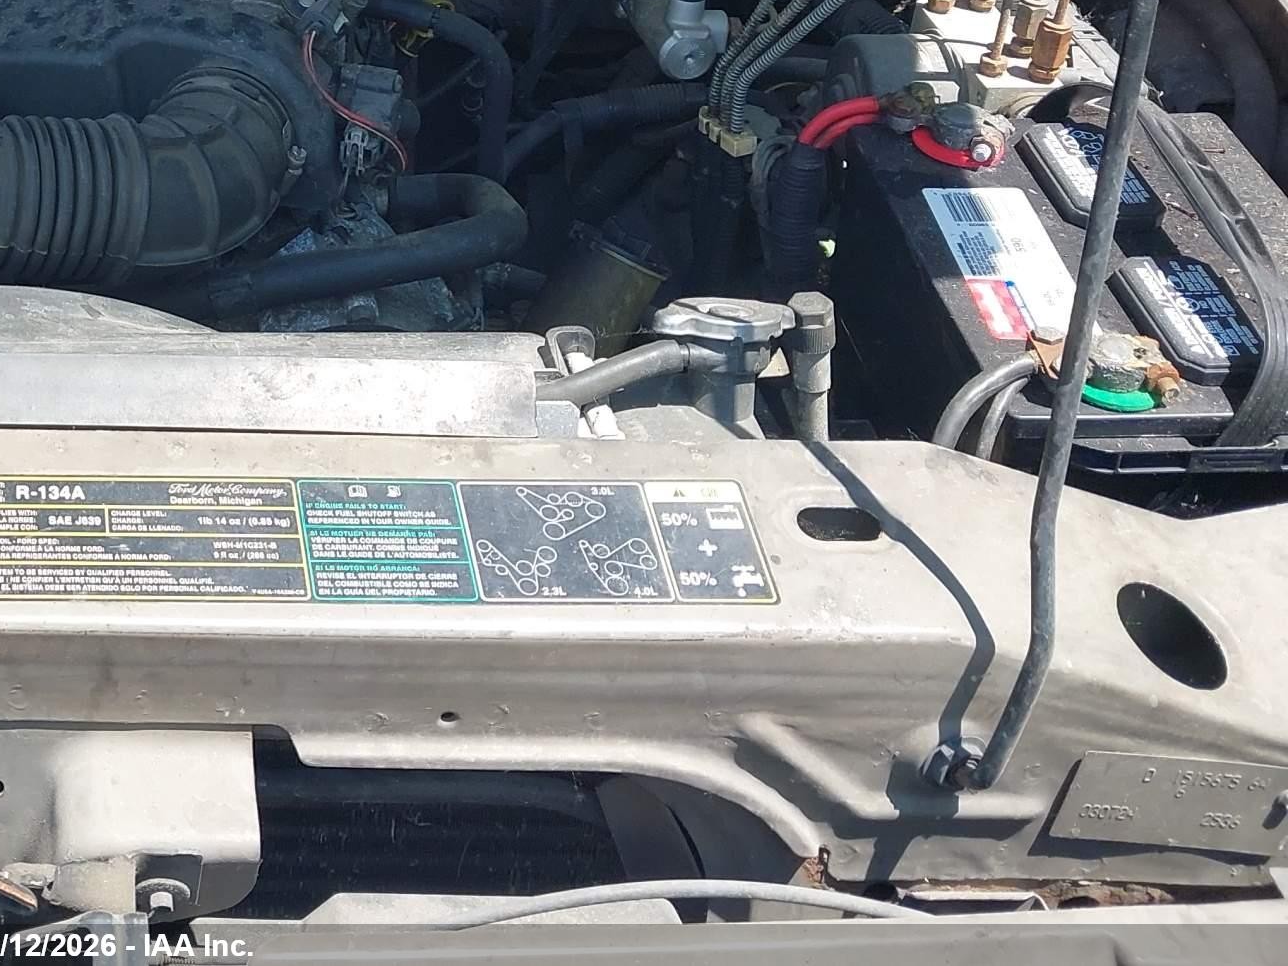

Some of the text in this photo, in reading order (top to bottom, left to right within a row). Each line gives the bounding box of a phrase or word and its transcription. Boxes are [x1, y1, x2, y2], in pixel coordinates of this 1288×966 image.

[15, 485, 85, 500] R-134A
[168, 483, 194, 494] Ford
[195, 483, 230, 496] Motor
[591, 486, 614, 496] 3.0L
[170, 496, 262, 506] Dearborn, Michigan
[48, 516, 101, 526] SAE J639
[215, 517, 226, 526] 14
[661, 513, 697, 526] 50%
[680, 572, 718, 586] 50%
[318, 588, 330, 596] EN
[331, 588, 343, 596] LA
[365, 588, 381, 596] DEL
[542, 586, 567, 596] 2.3L
[633, 586, 658, 596] 4.0L
